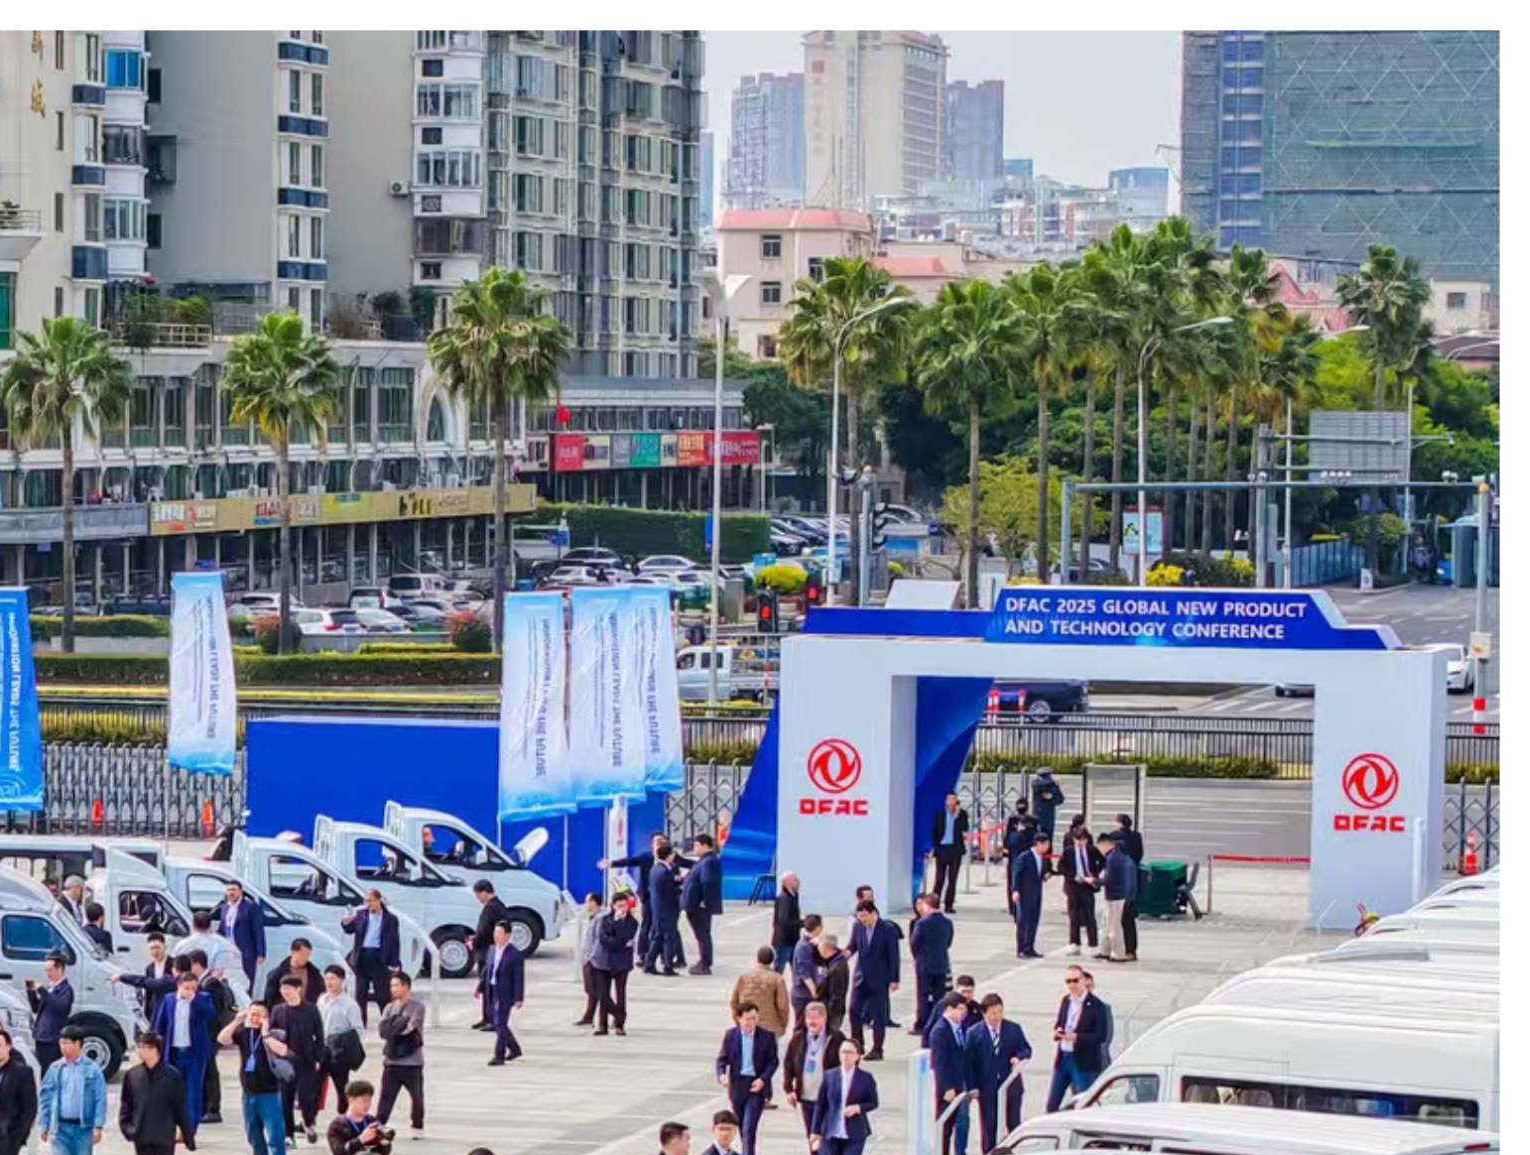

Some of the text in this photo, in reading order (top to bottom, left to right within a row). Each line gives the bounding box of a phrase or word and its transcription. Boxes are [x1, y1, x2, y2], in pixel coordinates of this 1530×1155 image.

[1005, 597, 1306, 618] DFAC 2025 GLOBAL NEW PRODUCT
[1005, 619, 1285, 639] AND TECHNOLOGY CONFERENCE
[799, 799, 868, 815] DFAC
[1334, 815, 1405, 832] DFAC
